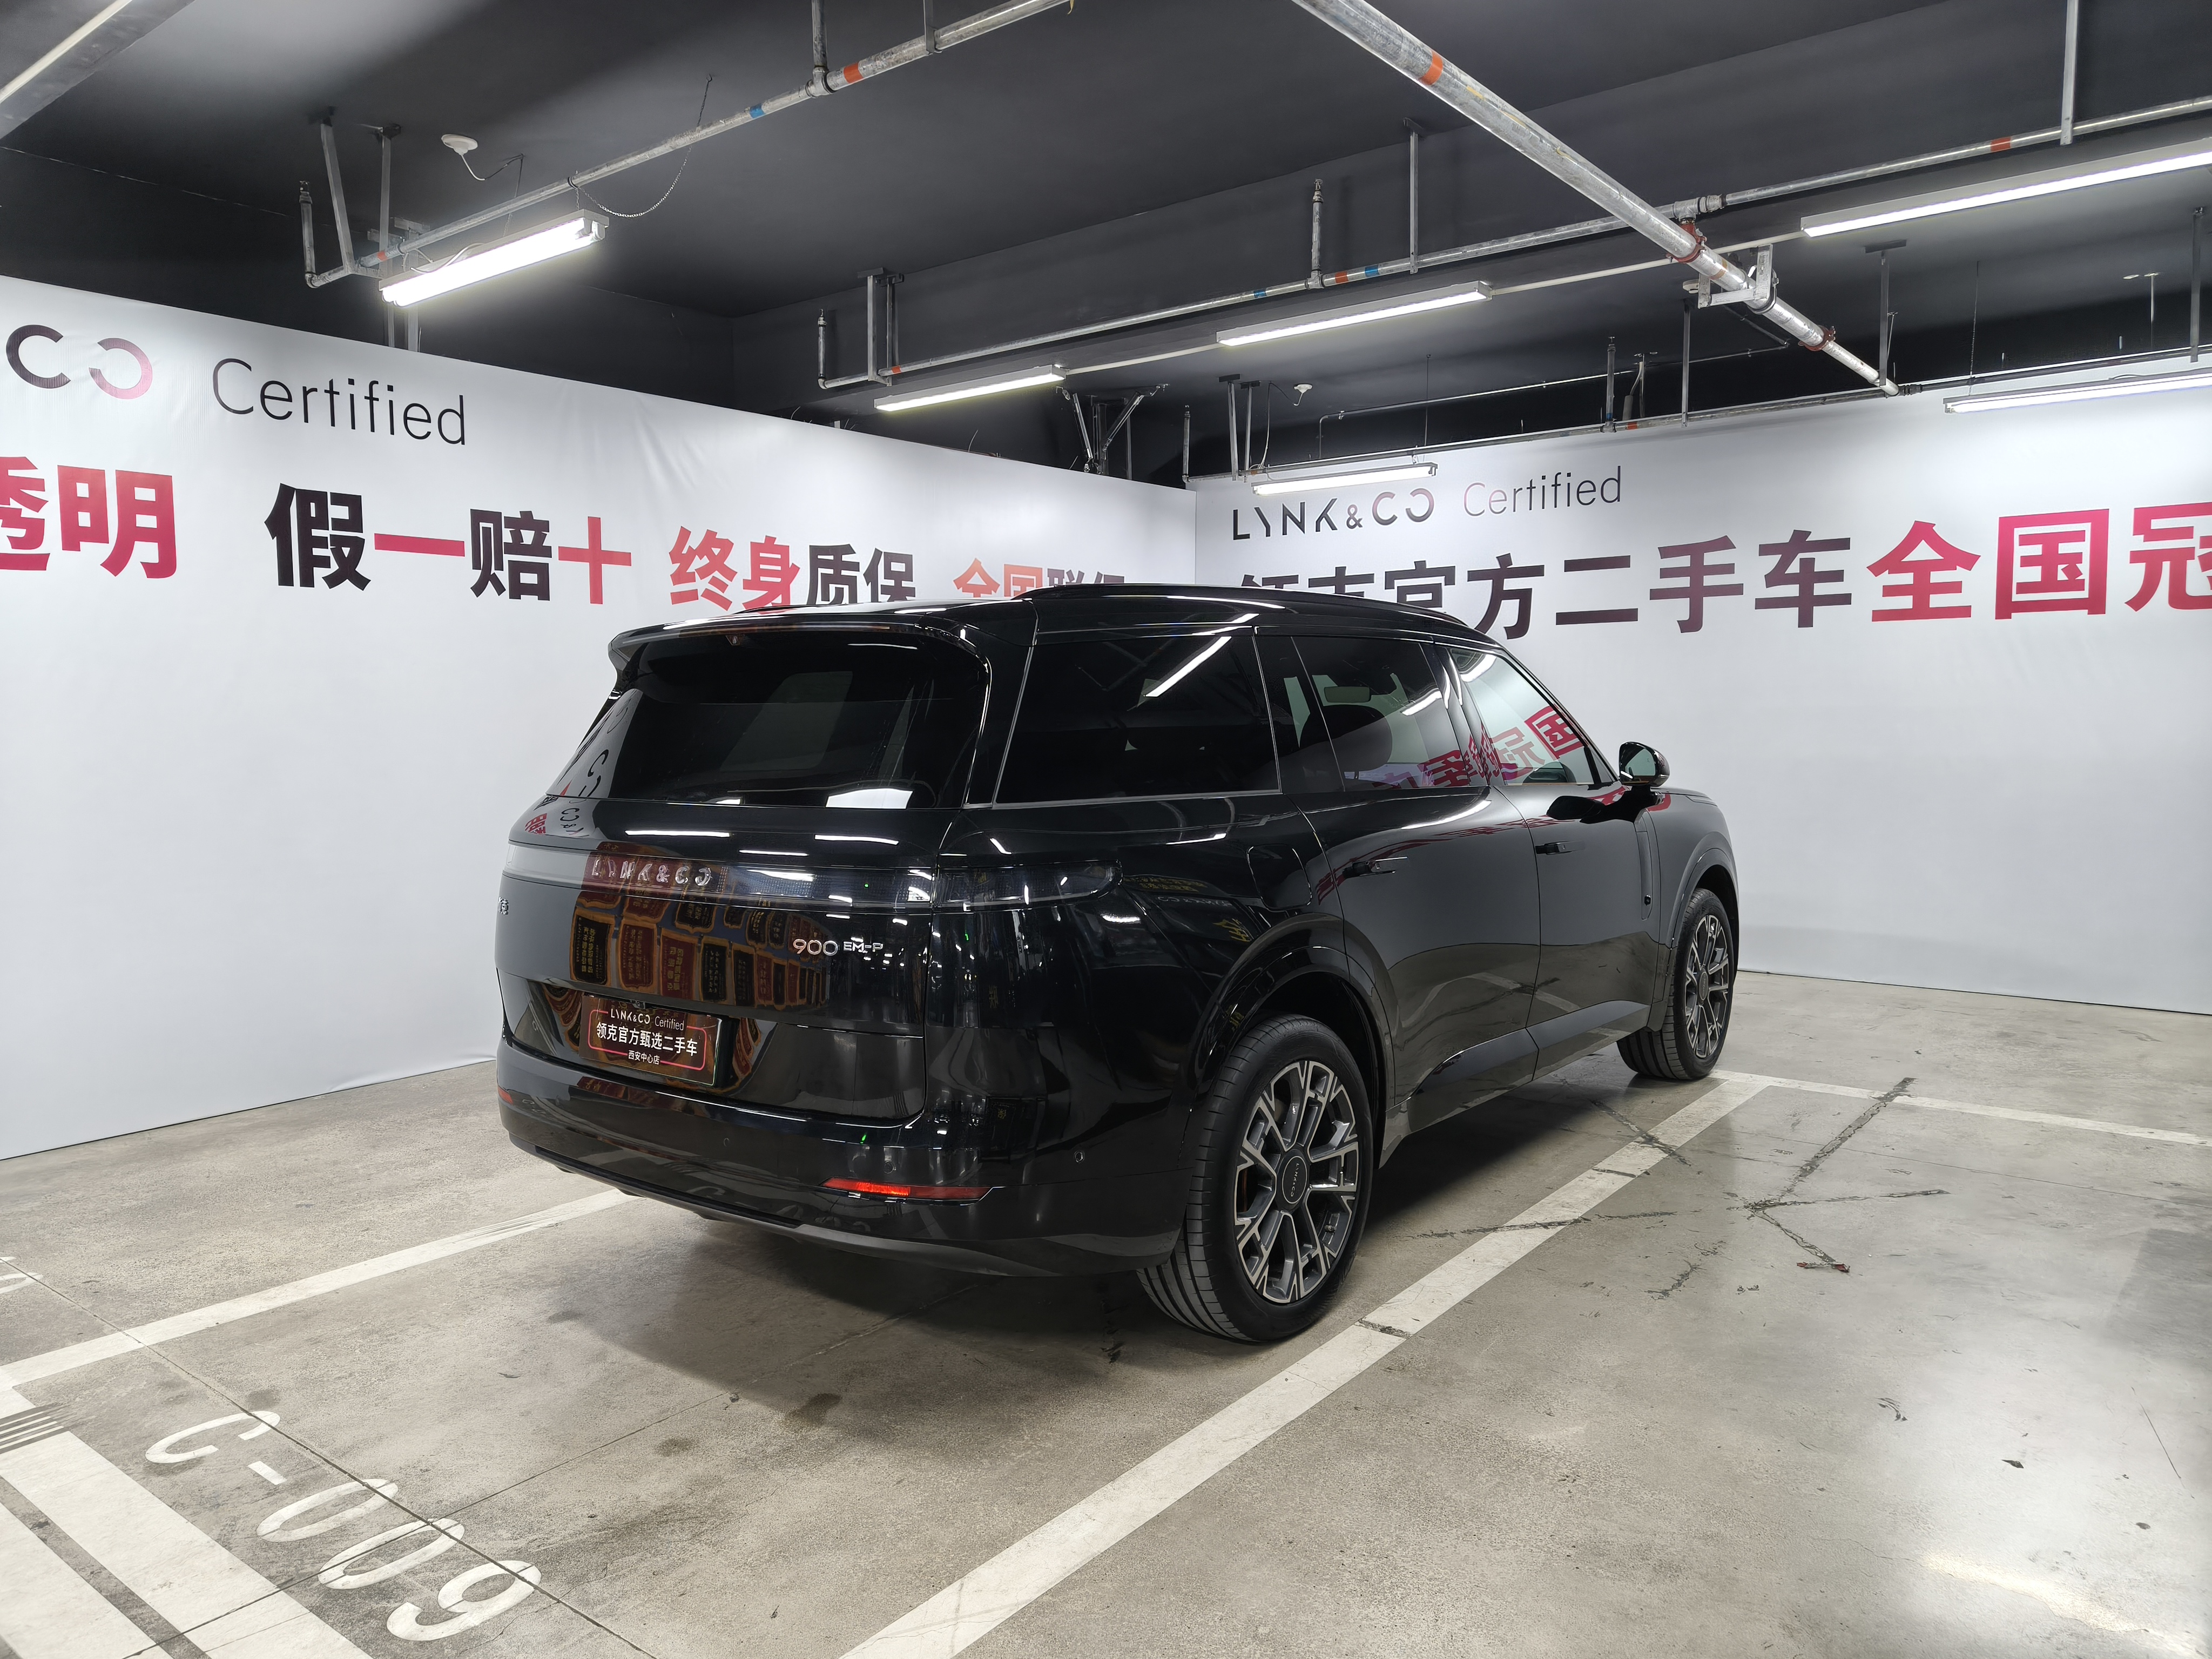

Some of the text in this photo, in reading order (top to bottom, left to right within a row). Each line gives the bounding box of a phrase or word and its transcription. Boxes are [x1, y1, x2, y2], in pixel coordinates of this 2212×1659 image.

[212, 358, 466, 446] Certified
[1232, 466, 1622, 541] LYNK&CO Certified
[264, 482, 632, 605] 假一赔十
[668, 525, 916, 611] 终身质保
[1241, 502, 2212, 639] 官方二手车全国冠
[591, 857, 713, 887] LYNK&CO
[793, 939, 884, 956] 900 EM-P
[596, 1021, 698, 1057] 领克官方甄选二手车
[611, 1008, 685, 1031] LYNK&CO Certified
[628, 1050, 660, 1065] 西安中心店
[144, 1410, 542, 1642] C-009
